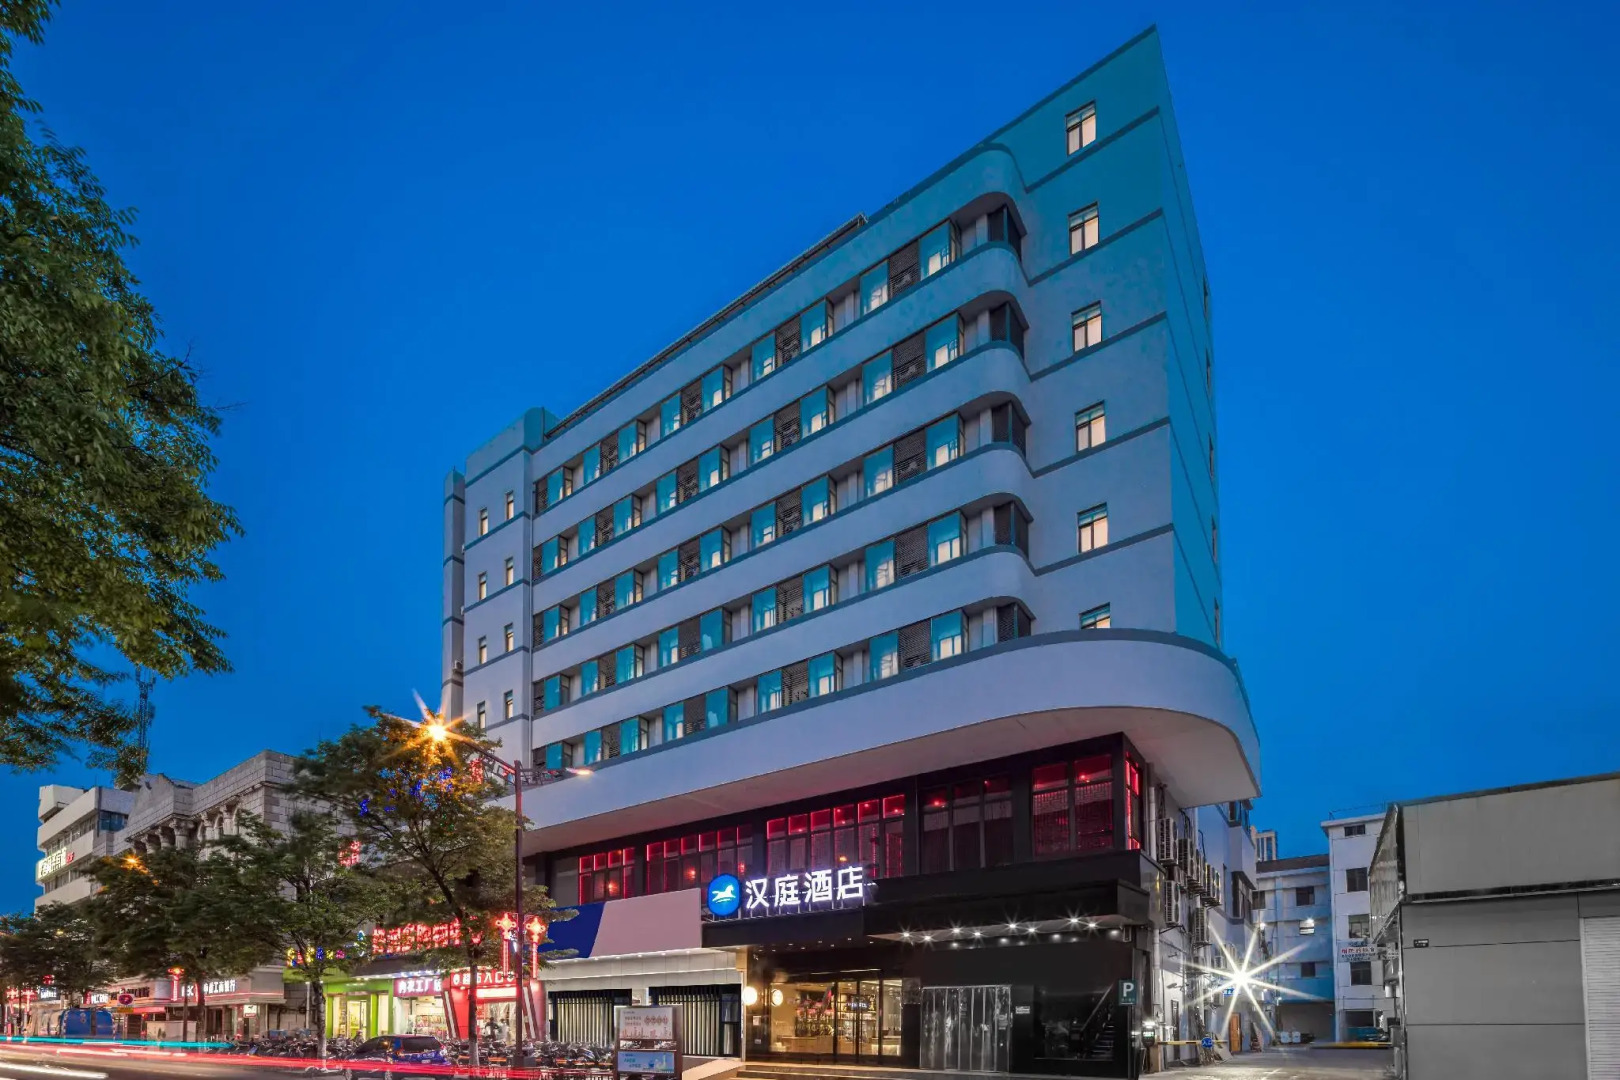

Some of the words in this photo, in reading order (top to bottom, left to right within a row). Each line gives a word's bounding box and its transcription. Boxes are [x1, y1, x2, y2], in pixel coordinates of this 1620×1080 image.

[745, 865, 864, 909] 汉庭酒店
[1122, 982, 1135, 998] P
